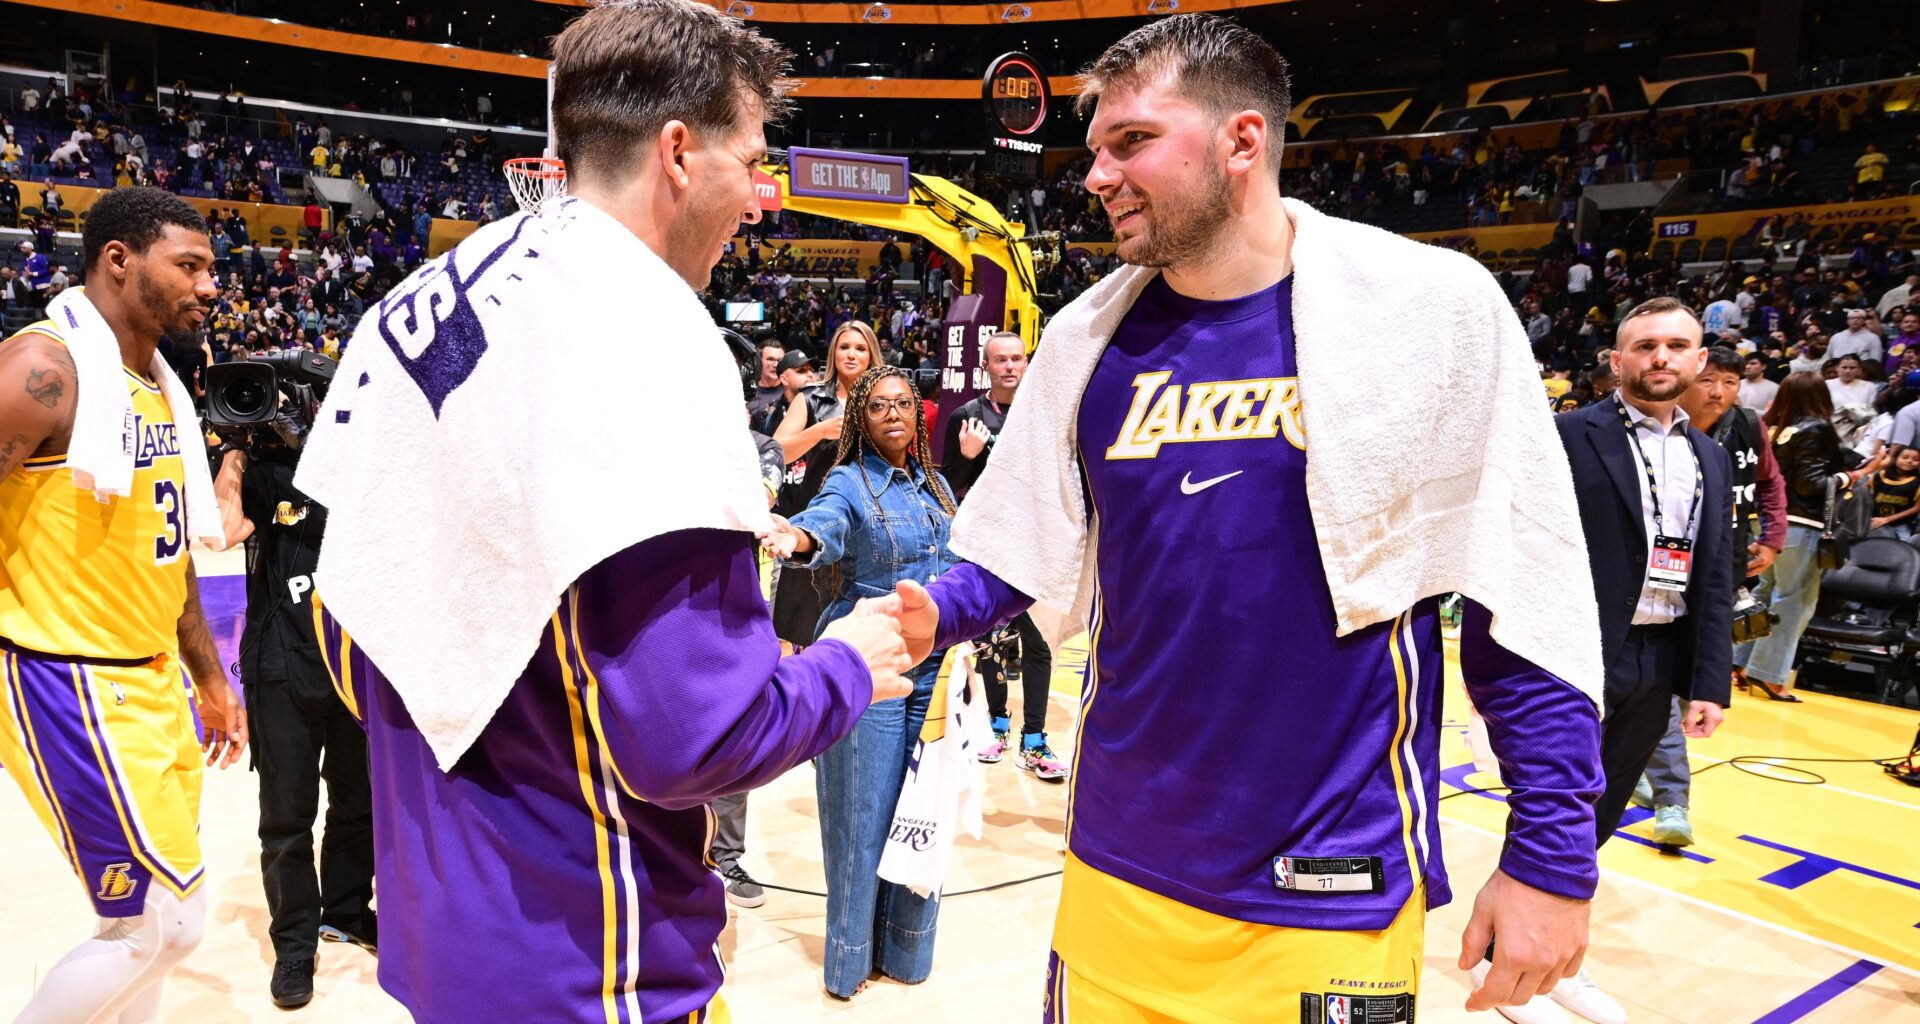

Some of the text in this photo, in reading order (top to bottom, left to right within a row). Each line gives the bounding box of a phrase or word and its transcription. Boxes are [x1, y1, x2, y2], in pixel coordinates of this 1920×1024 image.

[1008, 139, 1043, 154] TISSOT
[811, 162, 891, 195] GET THE App
[1664, 223, 1689, 236] 115
[948, 325, 965, 347] GET
[947, 347, 963, 367] THE
[949, 368, 965, 393] App
[1735, 447, 1759, 469] 34
[896, 816, 937, 828] ANGELES
[1317, 878, 1333, 889] 77
[1330, 978, 1366, 989] LEAVE
[1378, 980, 1408, 989] LEGACY
